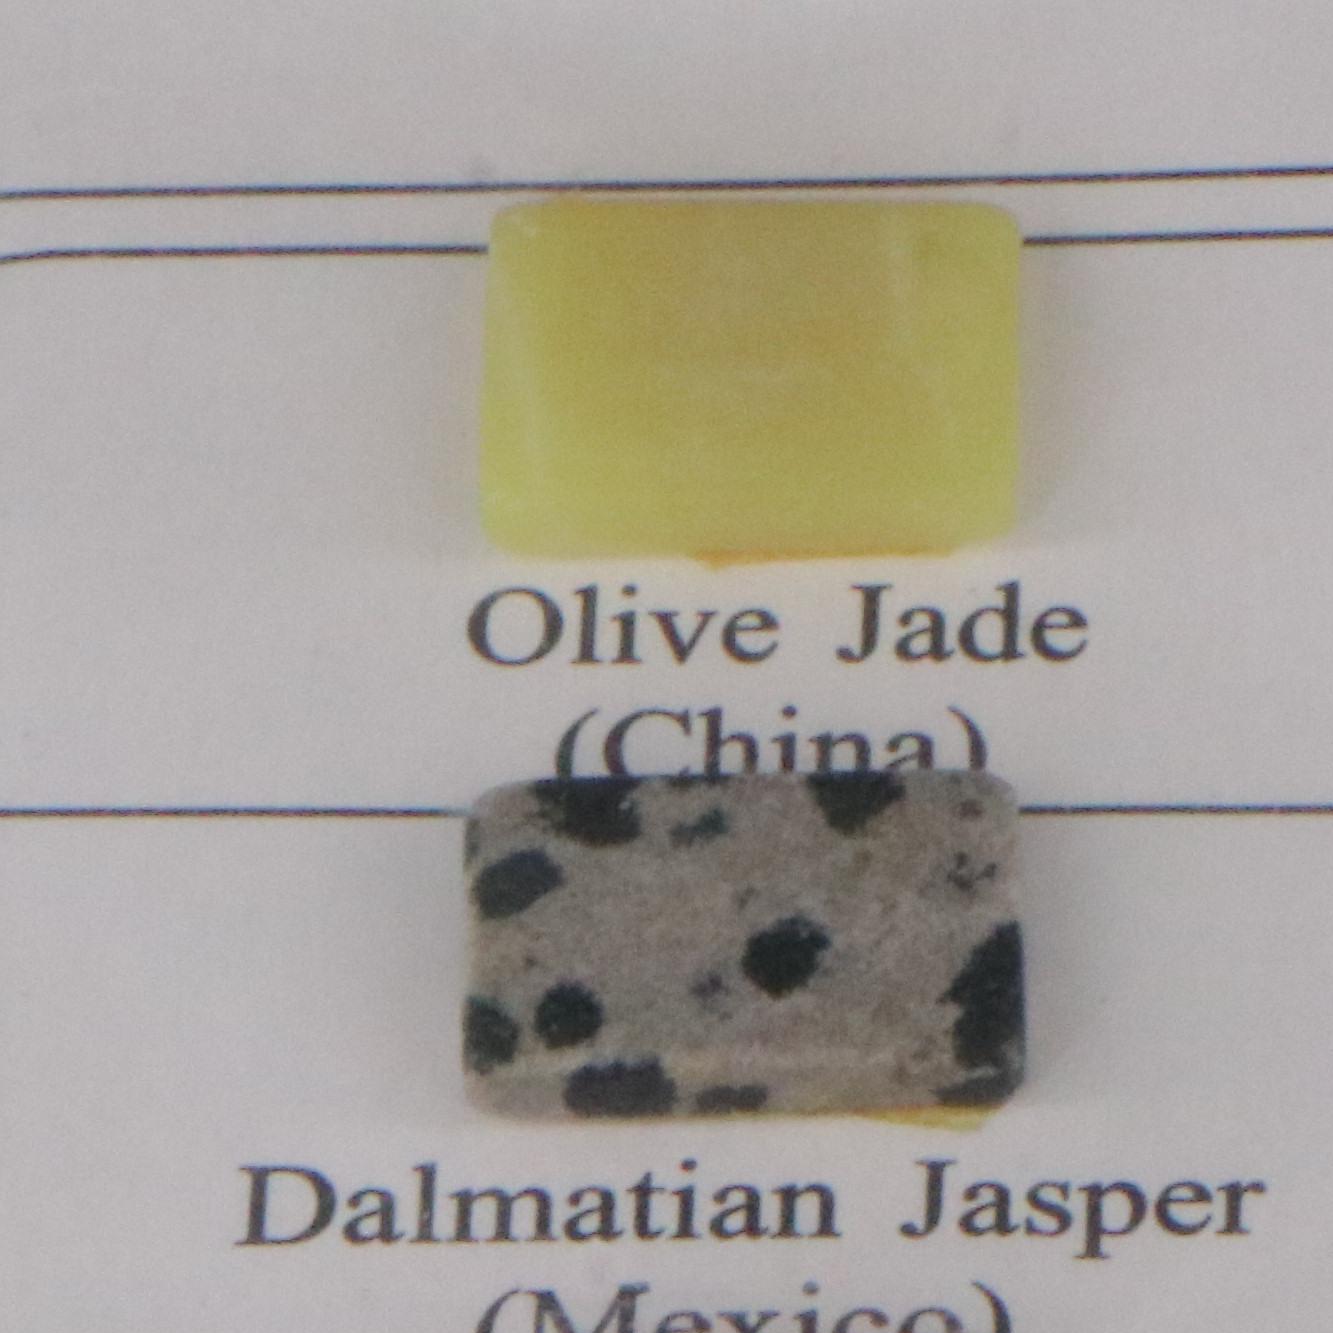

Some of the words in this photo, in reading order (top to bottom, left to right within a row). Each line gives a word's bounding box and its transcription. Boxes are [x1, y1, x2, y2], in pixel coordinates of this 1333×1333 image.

[465, 584, 779, 668] Olive
[836, 579, 1090, 665] Jade
[234, 1162, 840, 1248] Dalmatian
[899, 1159, 1268, 1261] Jasper
